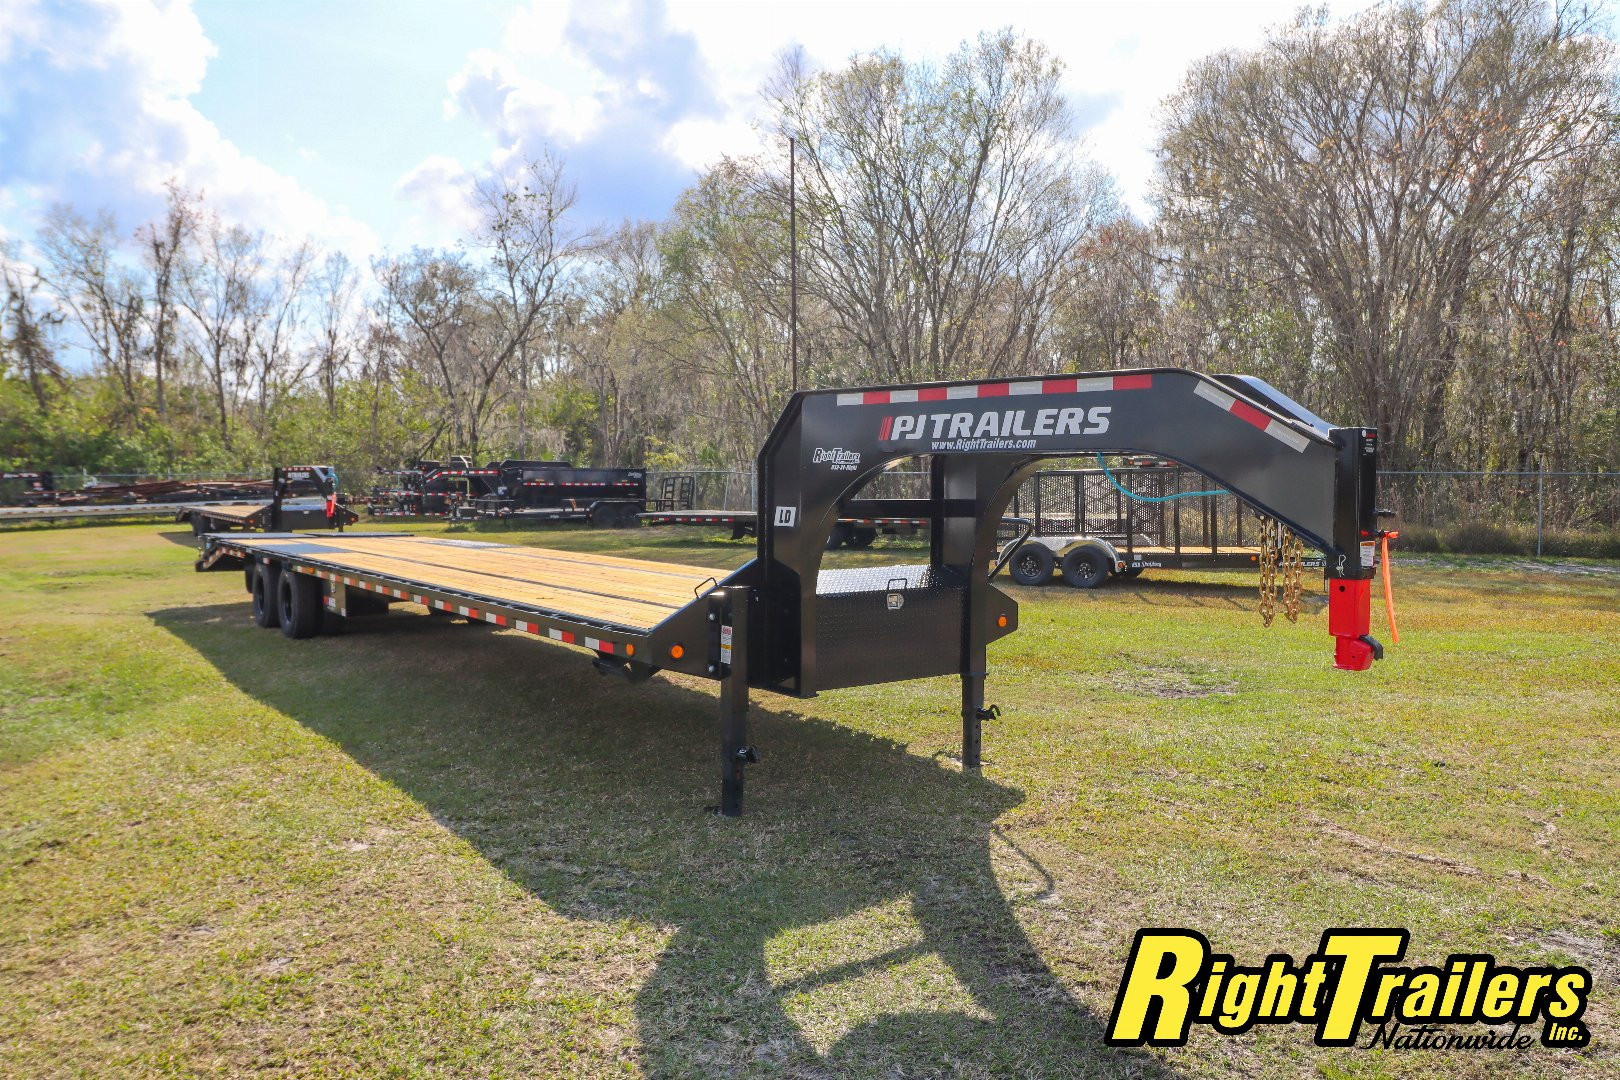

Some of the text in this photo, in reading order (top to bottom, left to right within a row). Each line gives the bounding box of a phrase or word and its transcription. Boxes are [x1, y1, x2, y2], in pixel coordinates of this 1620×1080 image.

[891, 407, 1111, 440] PJ TRAILERS
[931, 438, 1036, 451] www.RightTrailers.com
[779, 509, 791, 523] LD
